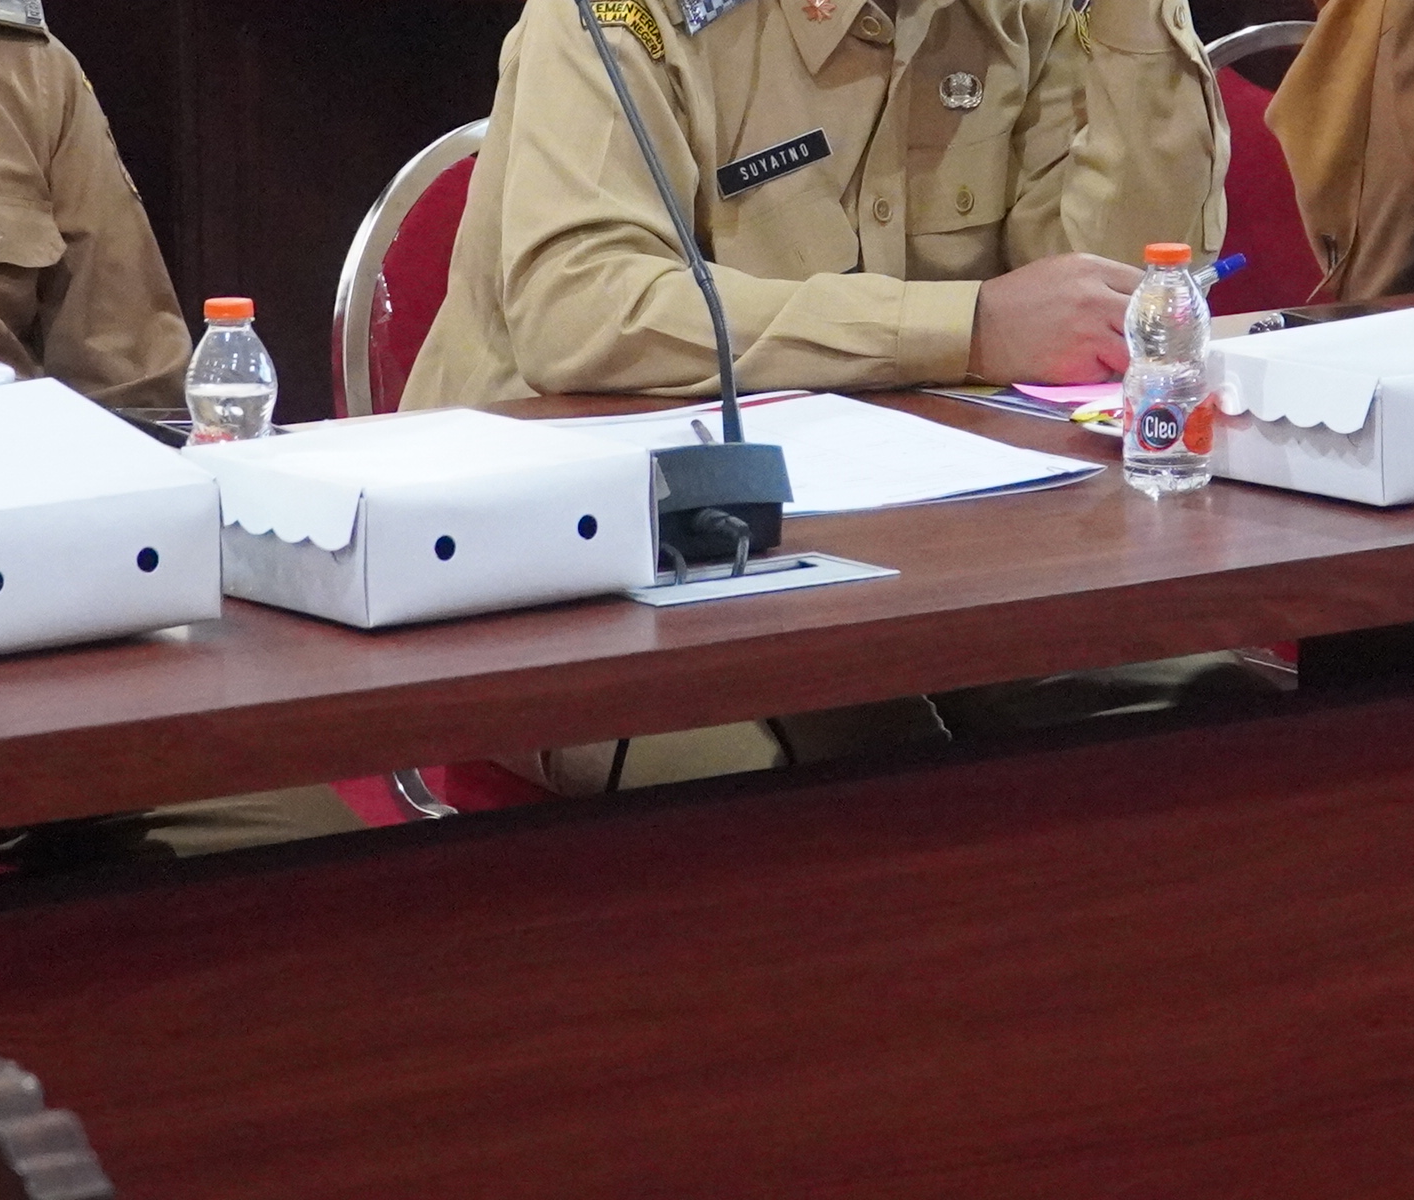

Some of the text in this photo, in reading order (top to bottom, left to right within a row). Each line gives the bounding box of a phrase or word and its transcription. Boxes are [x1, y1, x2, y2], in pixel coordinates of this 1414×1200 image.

[591, 2, 665, 51] EMENTERIA
[595, 13, 660, 55] ALAM NEGERI
[740, 143, 809, 180] SUYATNO
[1145, 416, 1177, 439] Cleo
